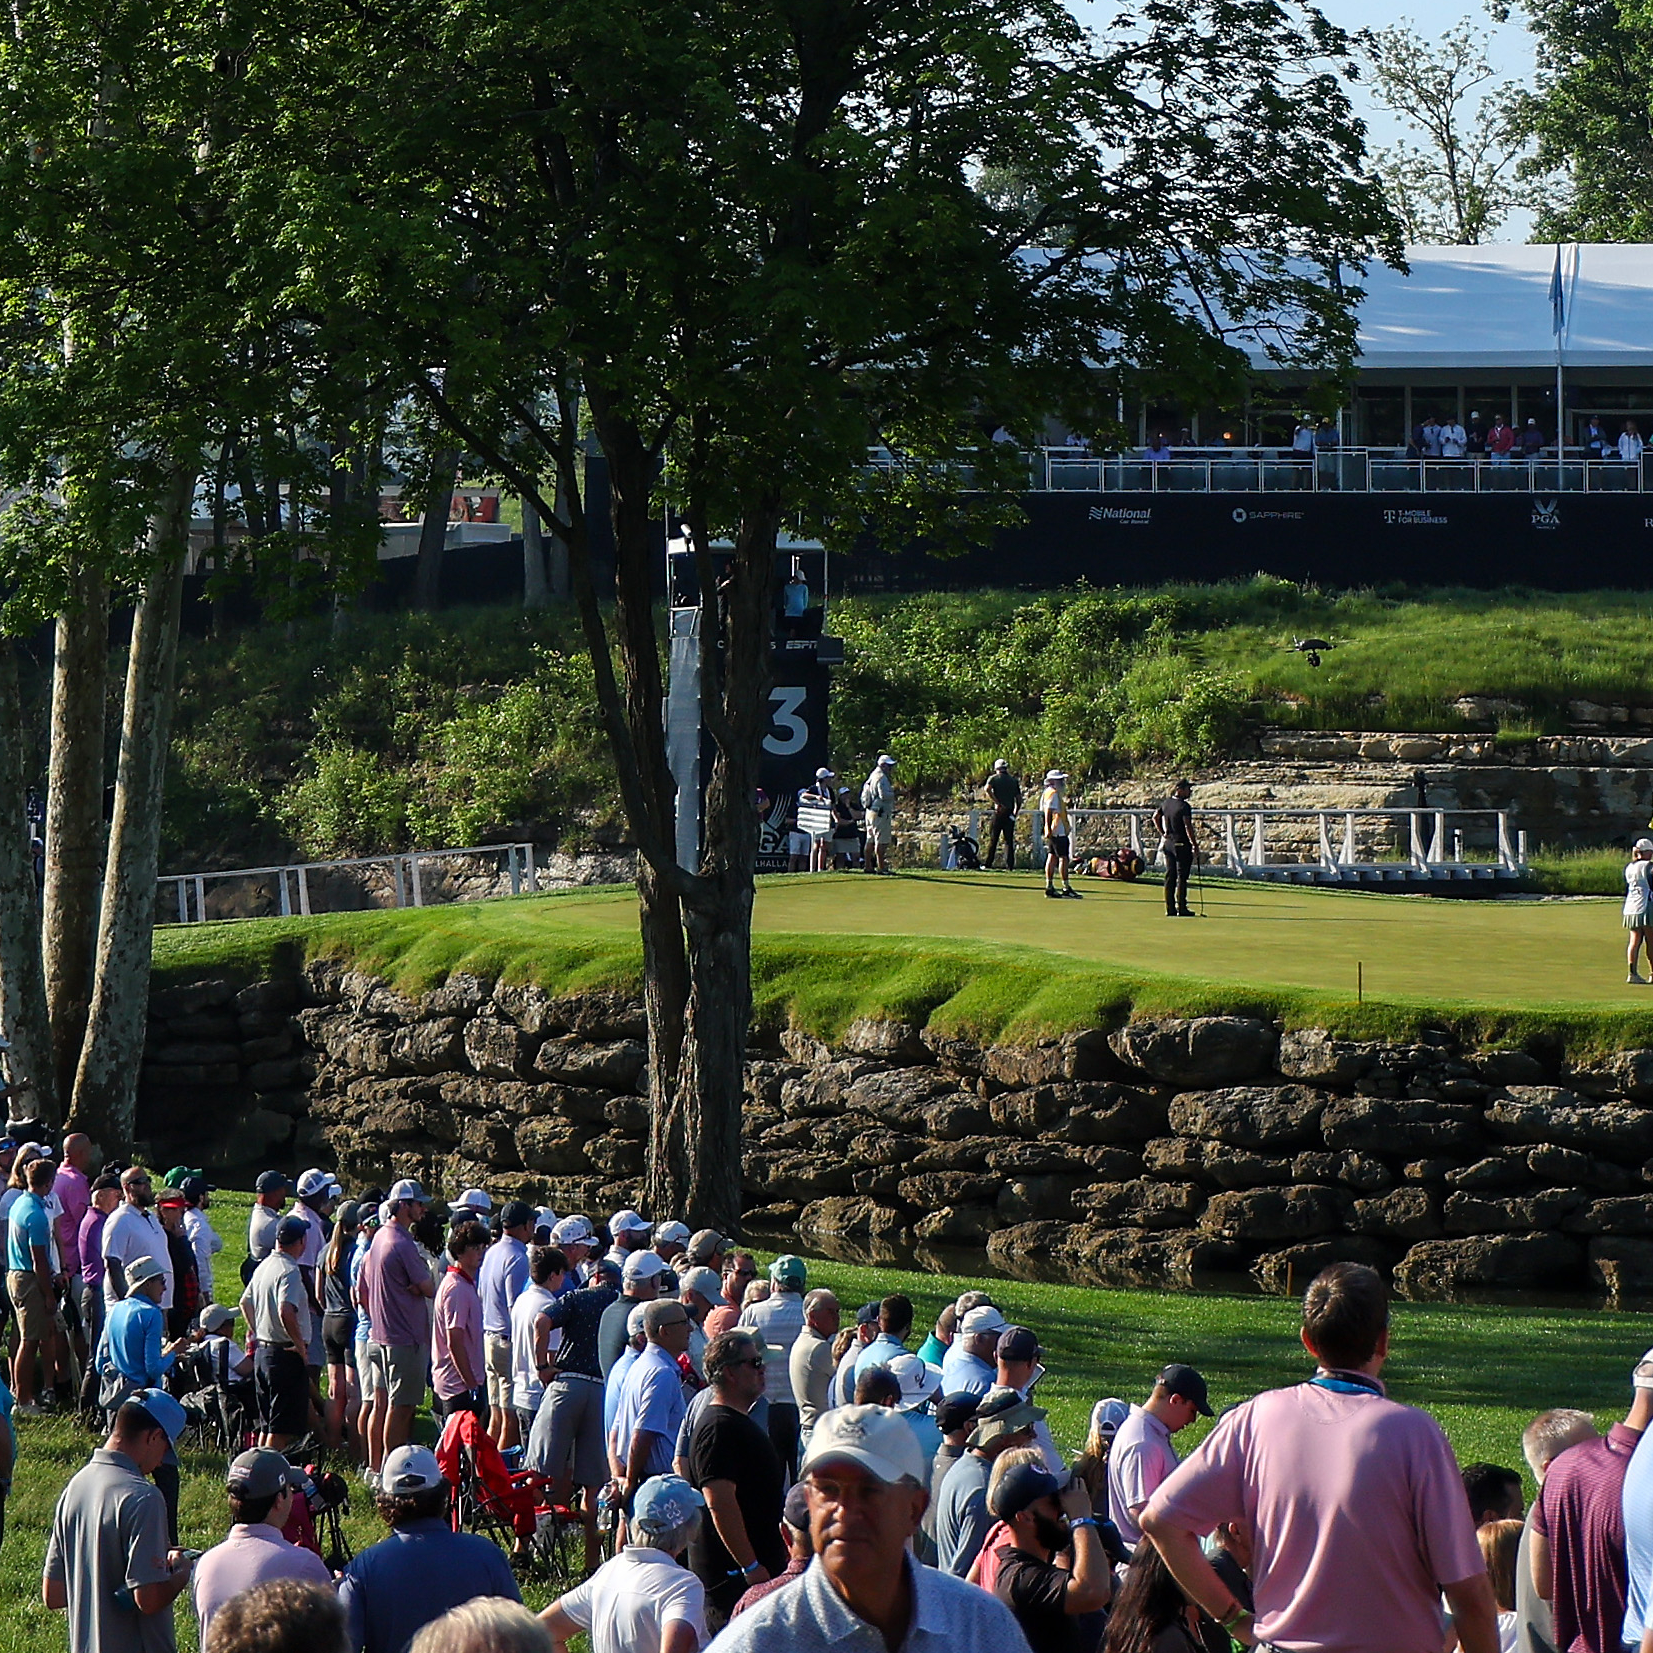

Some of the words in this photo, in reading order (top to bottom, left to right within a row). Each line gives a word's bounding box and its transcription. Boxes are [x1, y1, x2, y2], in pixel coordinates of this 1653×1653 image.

[1103, 507, 1151, 519] National
[1249, 511, 1303, 520] SAPPHIRE
[1398, 516, 1413, 524] FOR
[1413, 516, 1448, 524] BUSINESS
[1531, 514, 1561, 524] PGA
[762, 686, 810, 756] 3
[758, 833, 789, 854] GA
[755, 860, 788, 868] LHALLA
